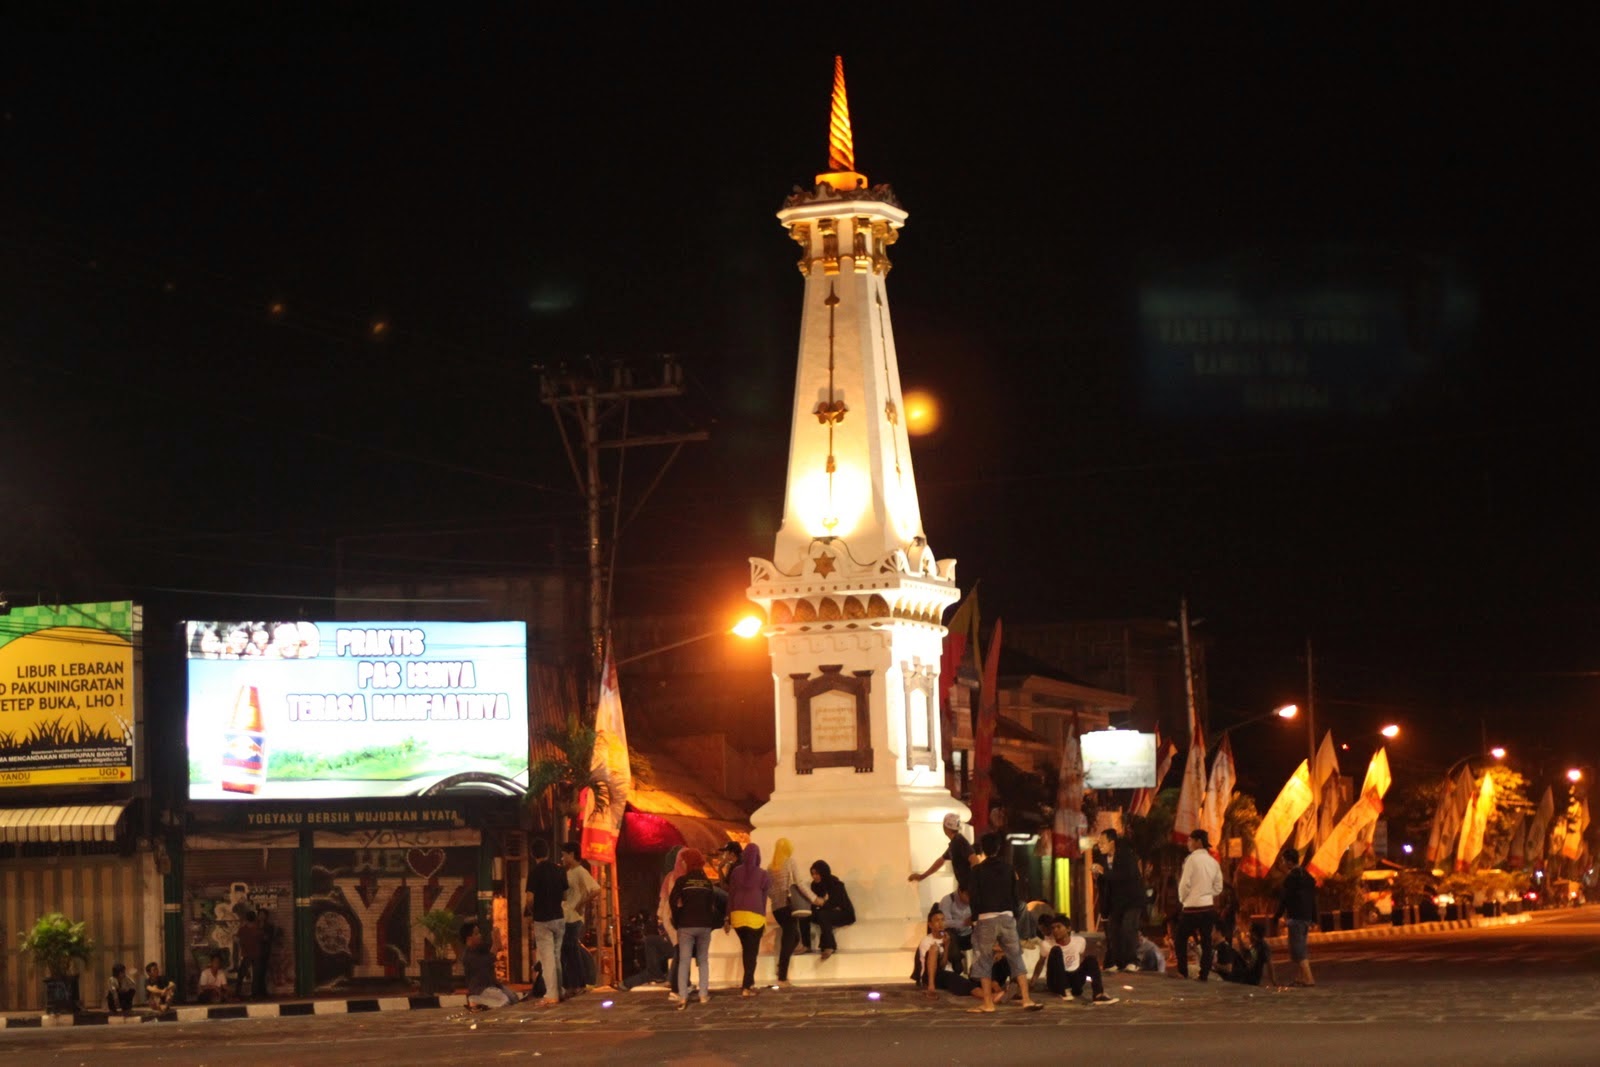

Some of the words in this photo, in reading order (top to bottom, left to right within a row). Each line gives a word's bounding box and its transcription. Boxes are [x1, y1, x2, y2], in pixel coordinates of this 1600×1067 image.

[336, 628, 425, 657] PRAKTIS
[17, 664, 56, 678] LIBUR
[61, 661, 124, 676] LEBARAN
[358, 661, 402, 689] PAS
[11, 678, 124, 695] PAKUNINGRATAN
[39, 695, 80, 711] BUKA,
[86, 695, 115, 708] LHO
[286, 694, 367, 721] TERASA
[99, 768, 119, 776] UGD
[248, 814, 302, 824] YOGYAKU
[307, 813, 349, 823] BERSIH
[422, 810, 458, 820] NYATA
